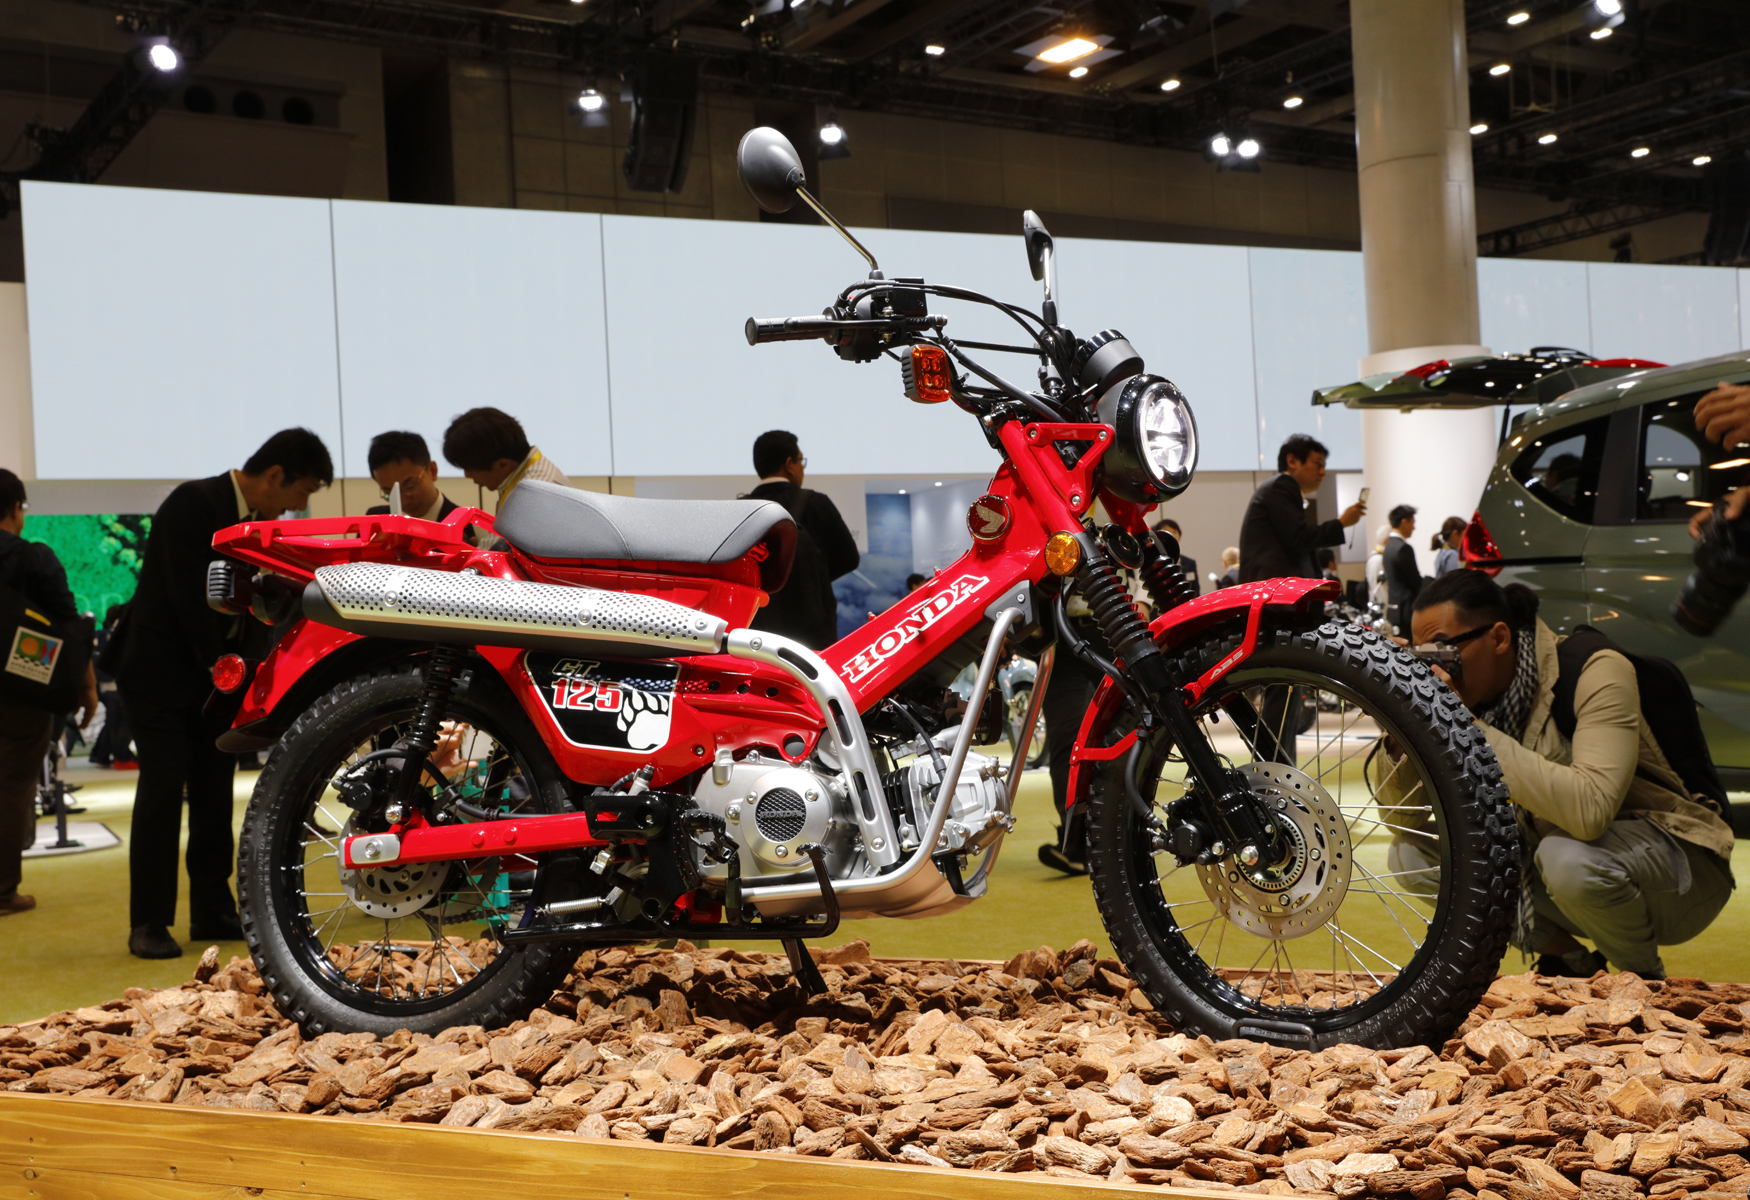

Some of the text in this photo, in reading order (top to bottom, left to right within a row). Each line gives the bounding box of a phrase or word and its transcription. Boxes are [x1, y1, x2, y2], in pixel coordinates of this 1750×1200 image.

[842, 574, 990, 683] HONDA
[552, 658, 600, 678] CT
[1210, 649, 1244, 680] ABS
[551, 677, 625, 713] 125
[760, 810, 804, 819] HONDA
